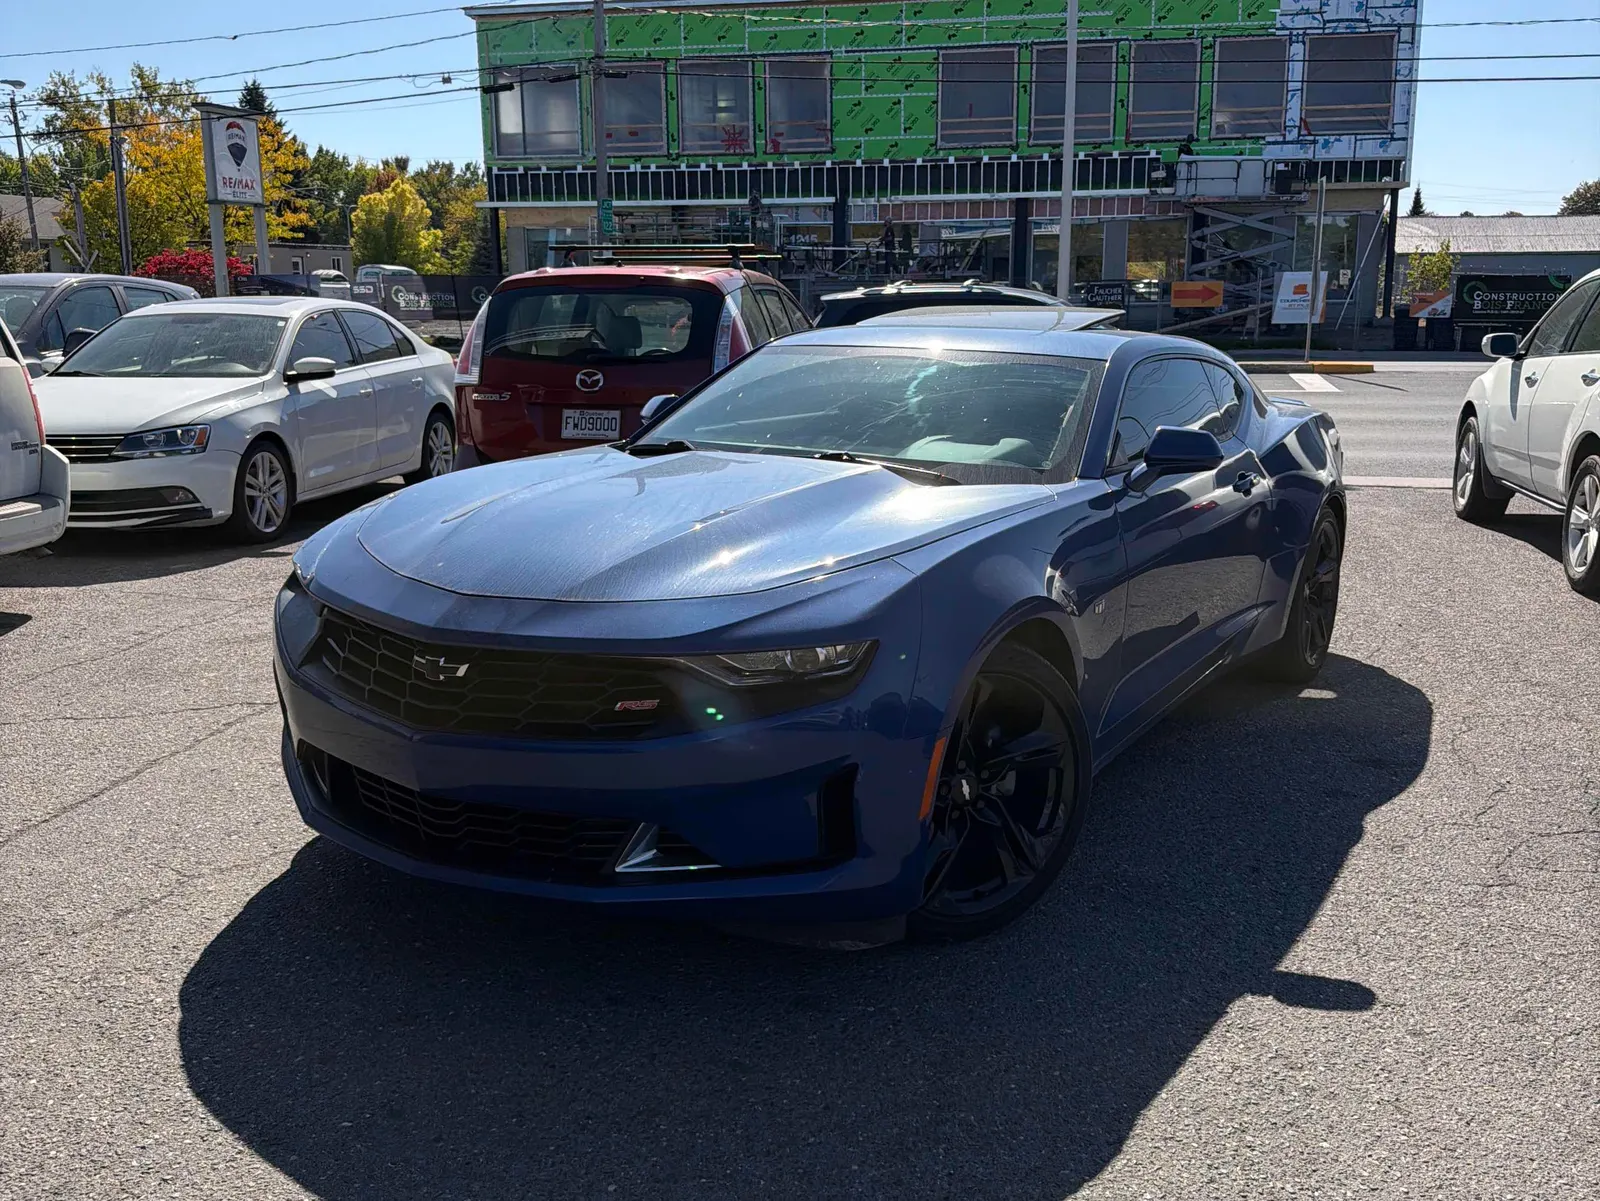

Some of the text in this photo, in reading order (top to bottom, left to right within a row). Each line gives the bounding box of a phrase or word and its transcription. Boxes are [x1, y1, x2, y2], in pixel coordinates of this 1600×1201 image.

[222, 177, 256, 190] RE/MAX
[1094, 286, 1123, 295] FAUCHER
[1473, 291, 1562, 301] CONSTRUCTION
[1088, 293, 1123, 302] GAUTHIER
[565, 416, 618, 431] FWD9000
[614, 699, 660, 711] RS
